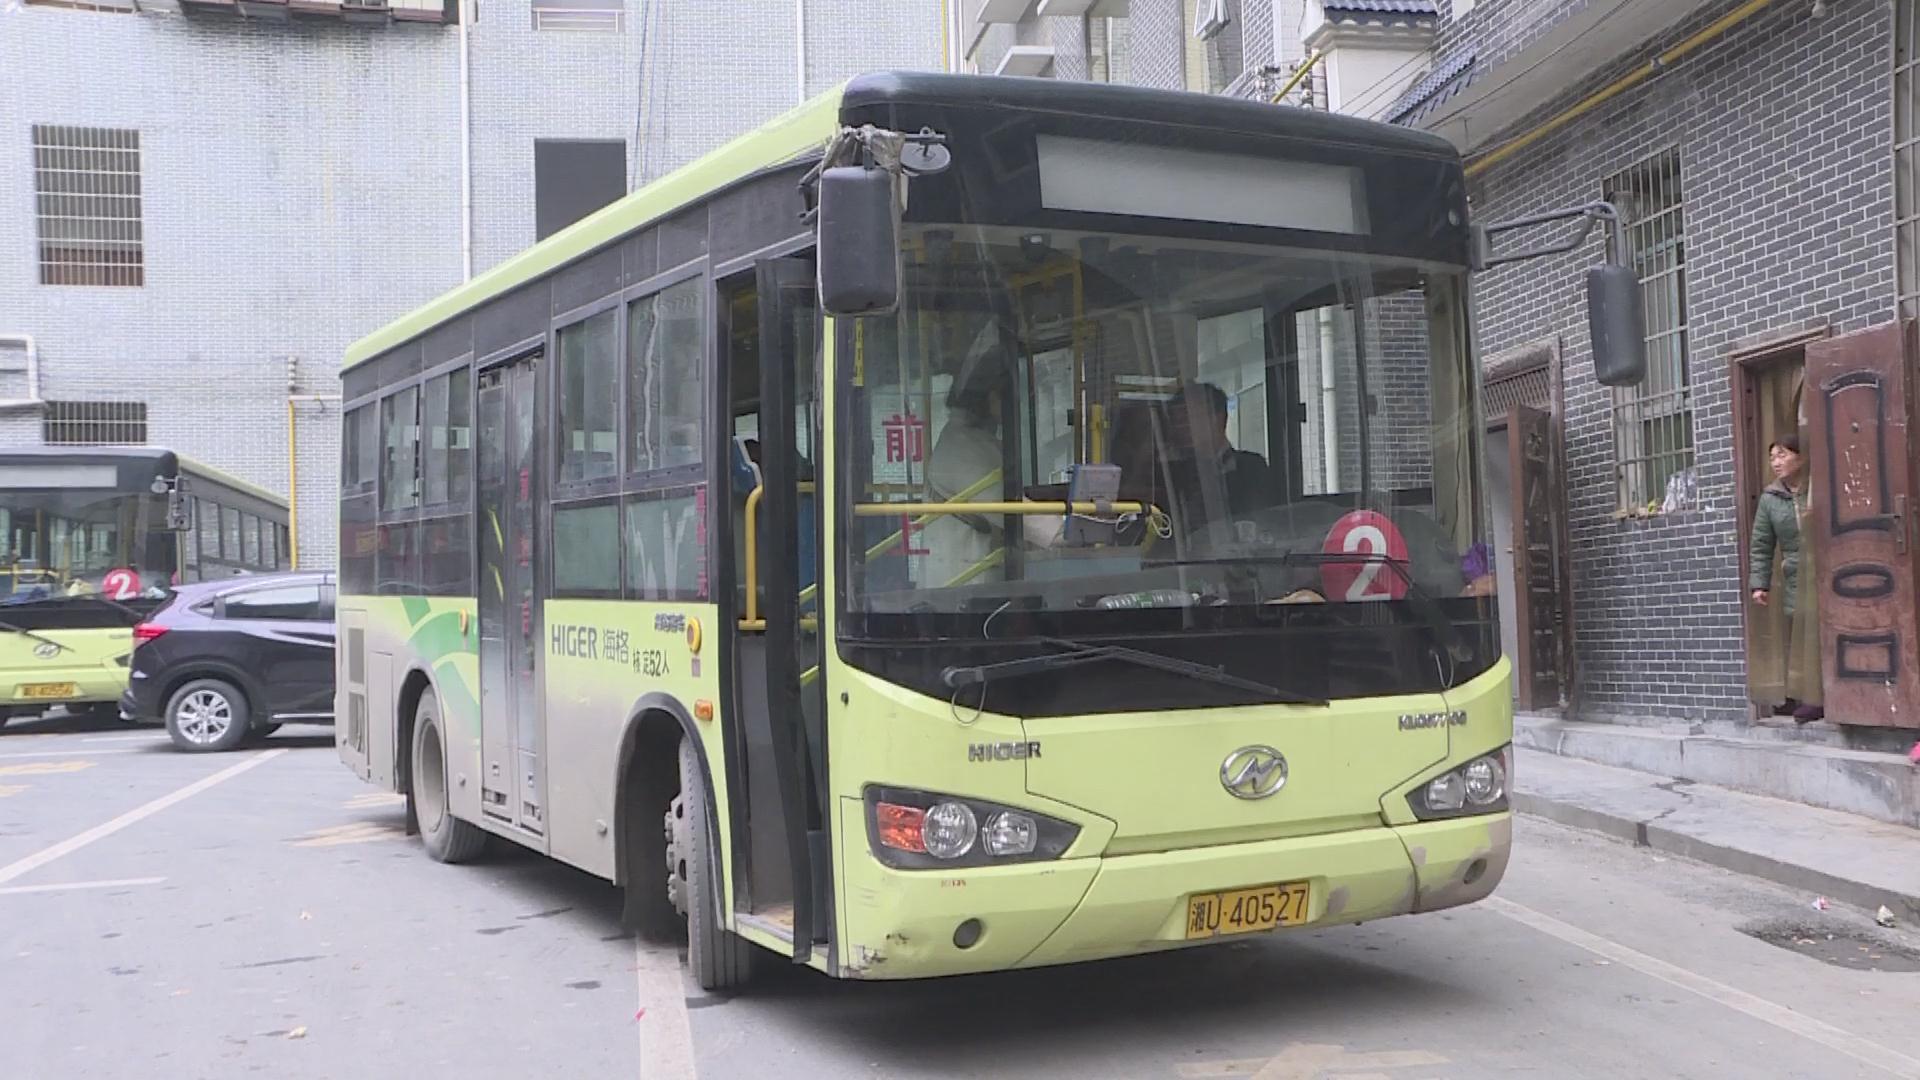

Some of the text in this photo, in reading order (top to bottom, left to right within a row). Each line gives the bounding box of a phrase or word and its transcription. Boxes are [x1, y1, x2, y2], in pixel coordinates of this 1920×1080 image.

[882, 413, 926, 464] 前
[1343, 525, 1391, 602] 2
[110, 573, 137, 601] 2
[551, 624, 630, 664] HIGER 海格
[968, 741, 1042, 762] HIGER
